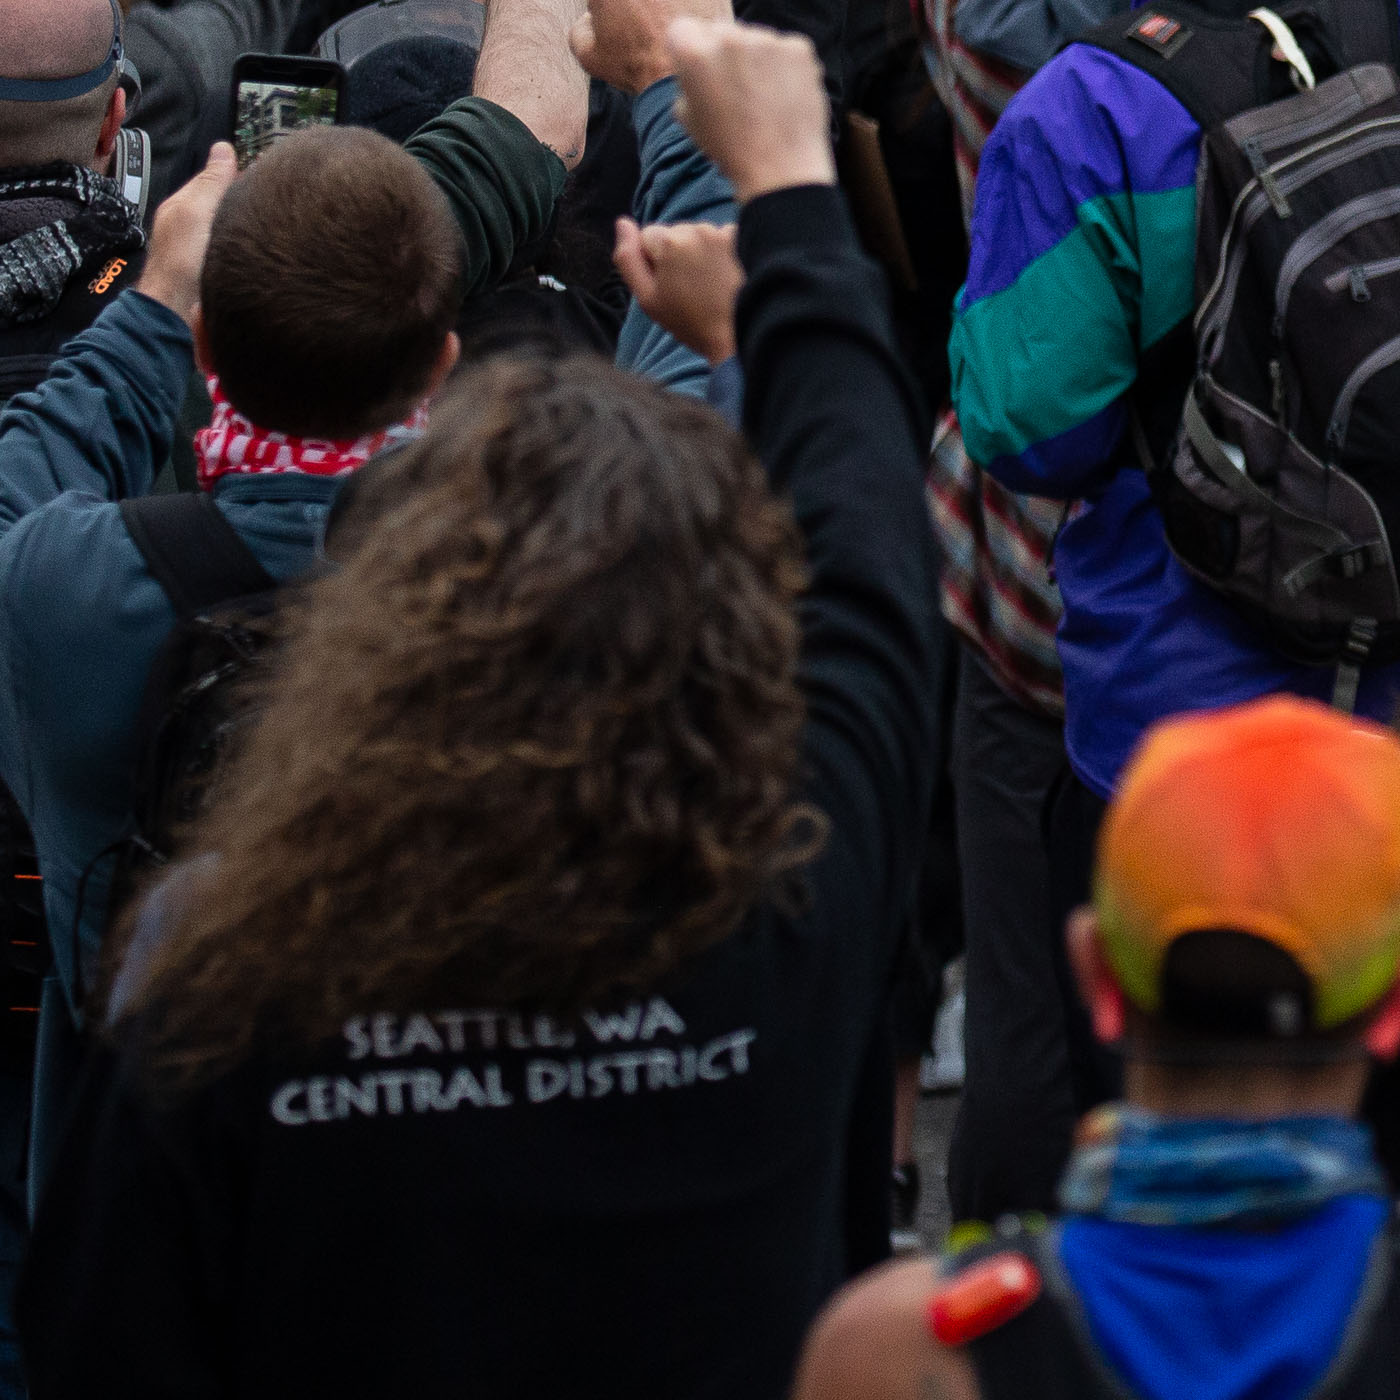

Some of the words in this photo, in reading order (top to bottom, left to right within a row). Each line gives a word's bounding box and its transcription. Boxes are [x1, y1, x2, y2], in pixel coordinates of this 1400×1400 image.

[95, 258, 128, 294] LOAD
[585, 997, 686, 1043] WA
[270, 1065, 513, 1126] CENTRAL
[525, 1027, 756, 1103] DISTRICT
